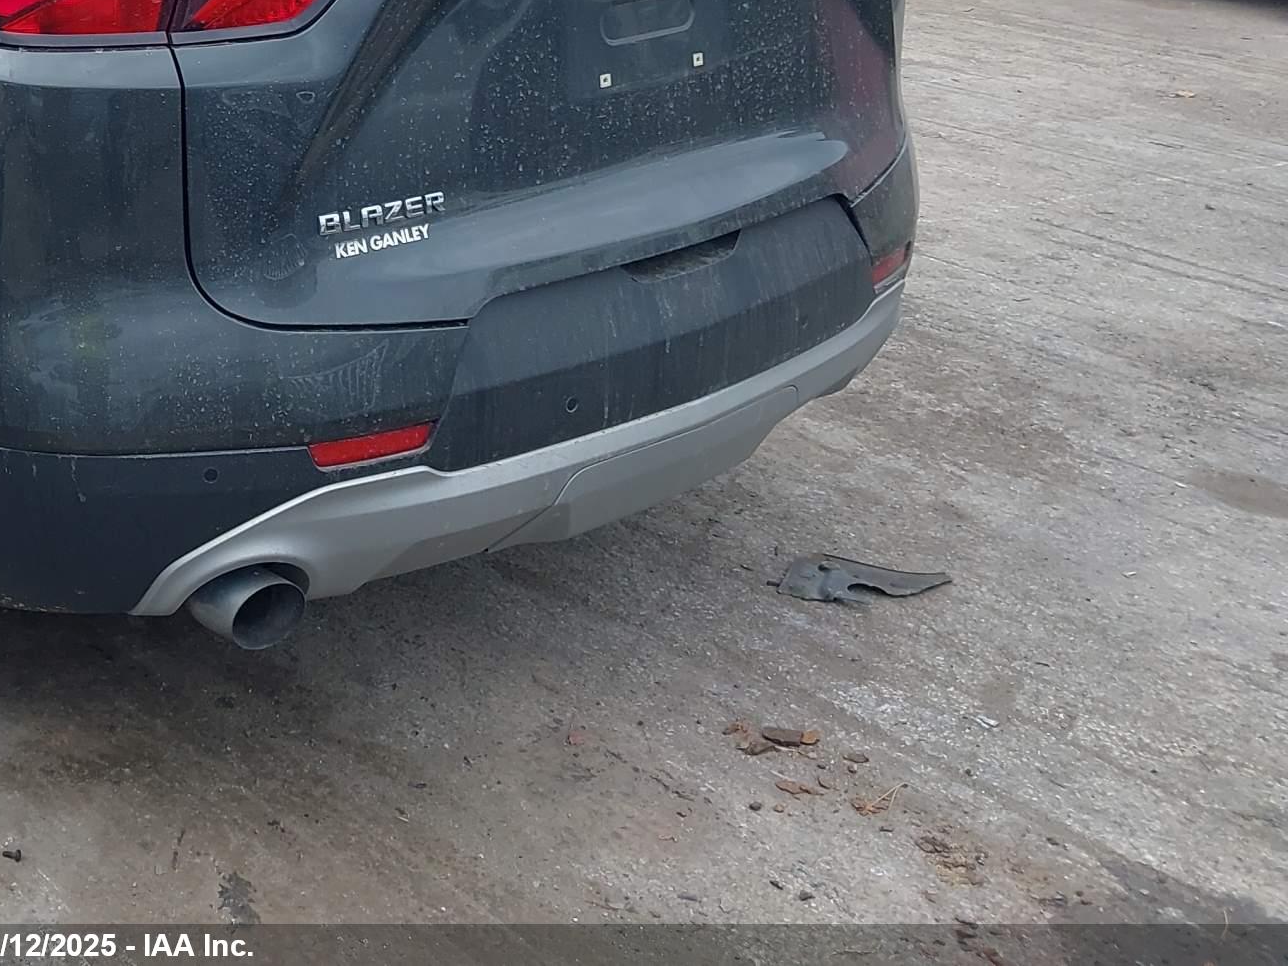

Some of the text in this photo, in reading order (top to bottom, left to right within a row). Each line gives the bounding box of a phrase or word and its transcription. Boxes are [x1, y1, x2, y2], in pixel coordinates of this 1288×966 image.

[318, 191, 446, 236] BLAZER
[335, 223, 430, 259] KEN GANLEY
